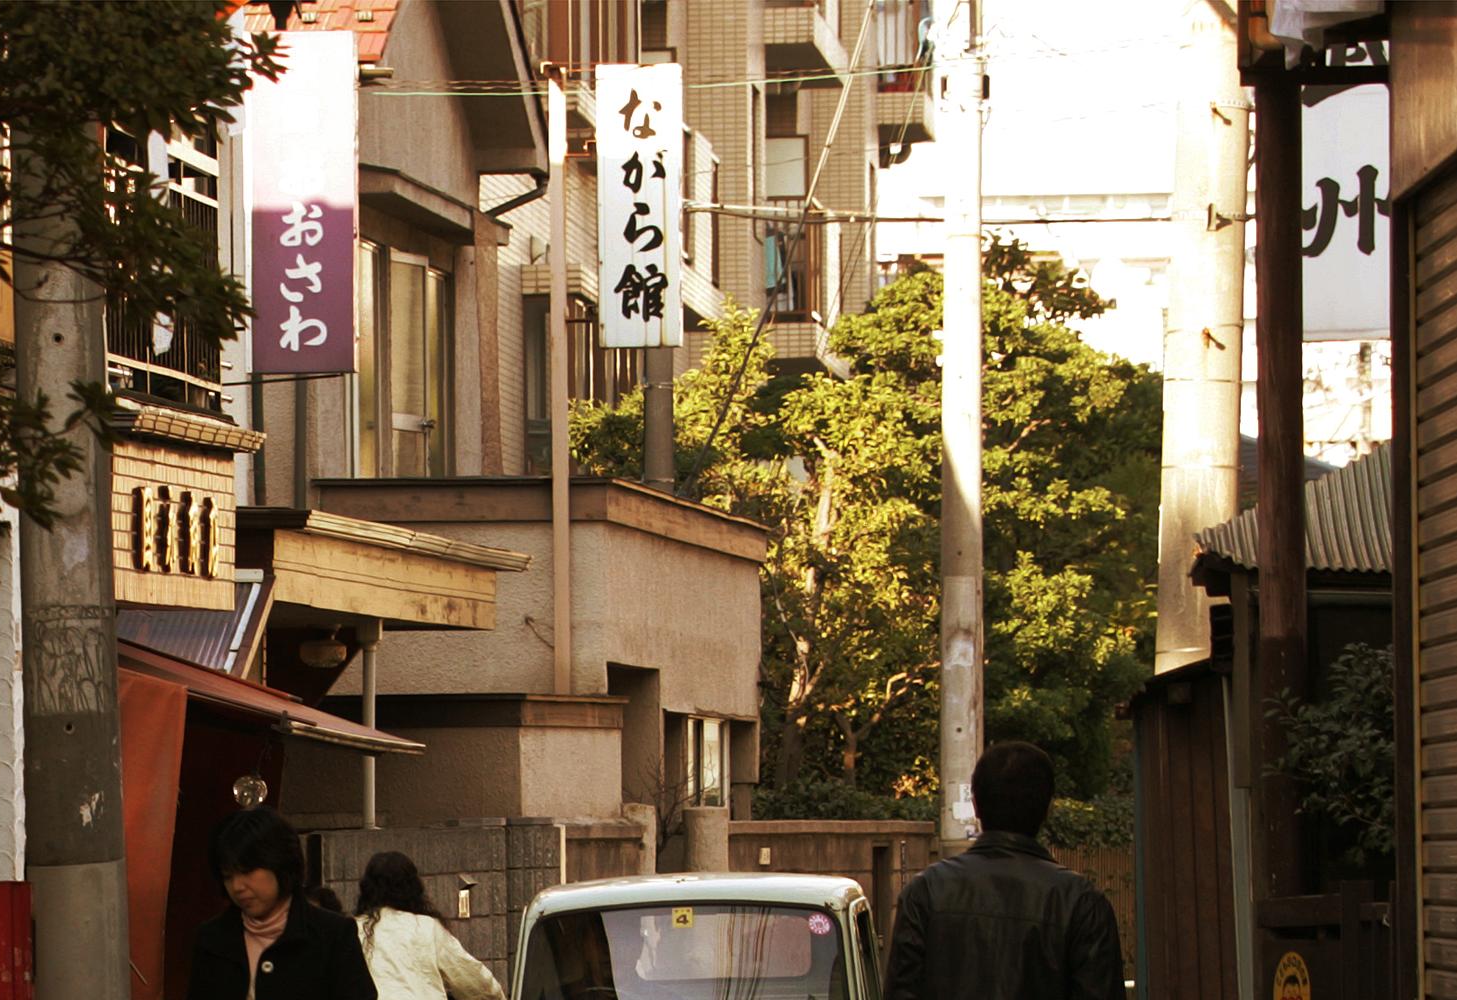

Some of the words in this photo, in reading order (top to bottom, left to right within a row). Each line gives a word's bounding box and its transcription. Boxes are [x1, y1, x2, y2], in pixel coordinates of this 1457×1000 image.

[614, 89, 668, 323] ながら館
[676, 914, 689, 926] 4
